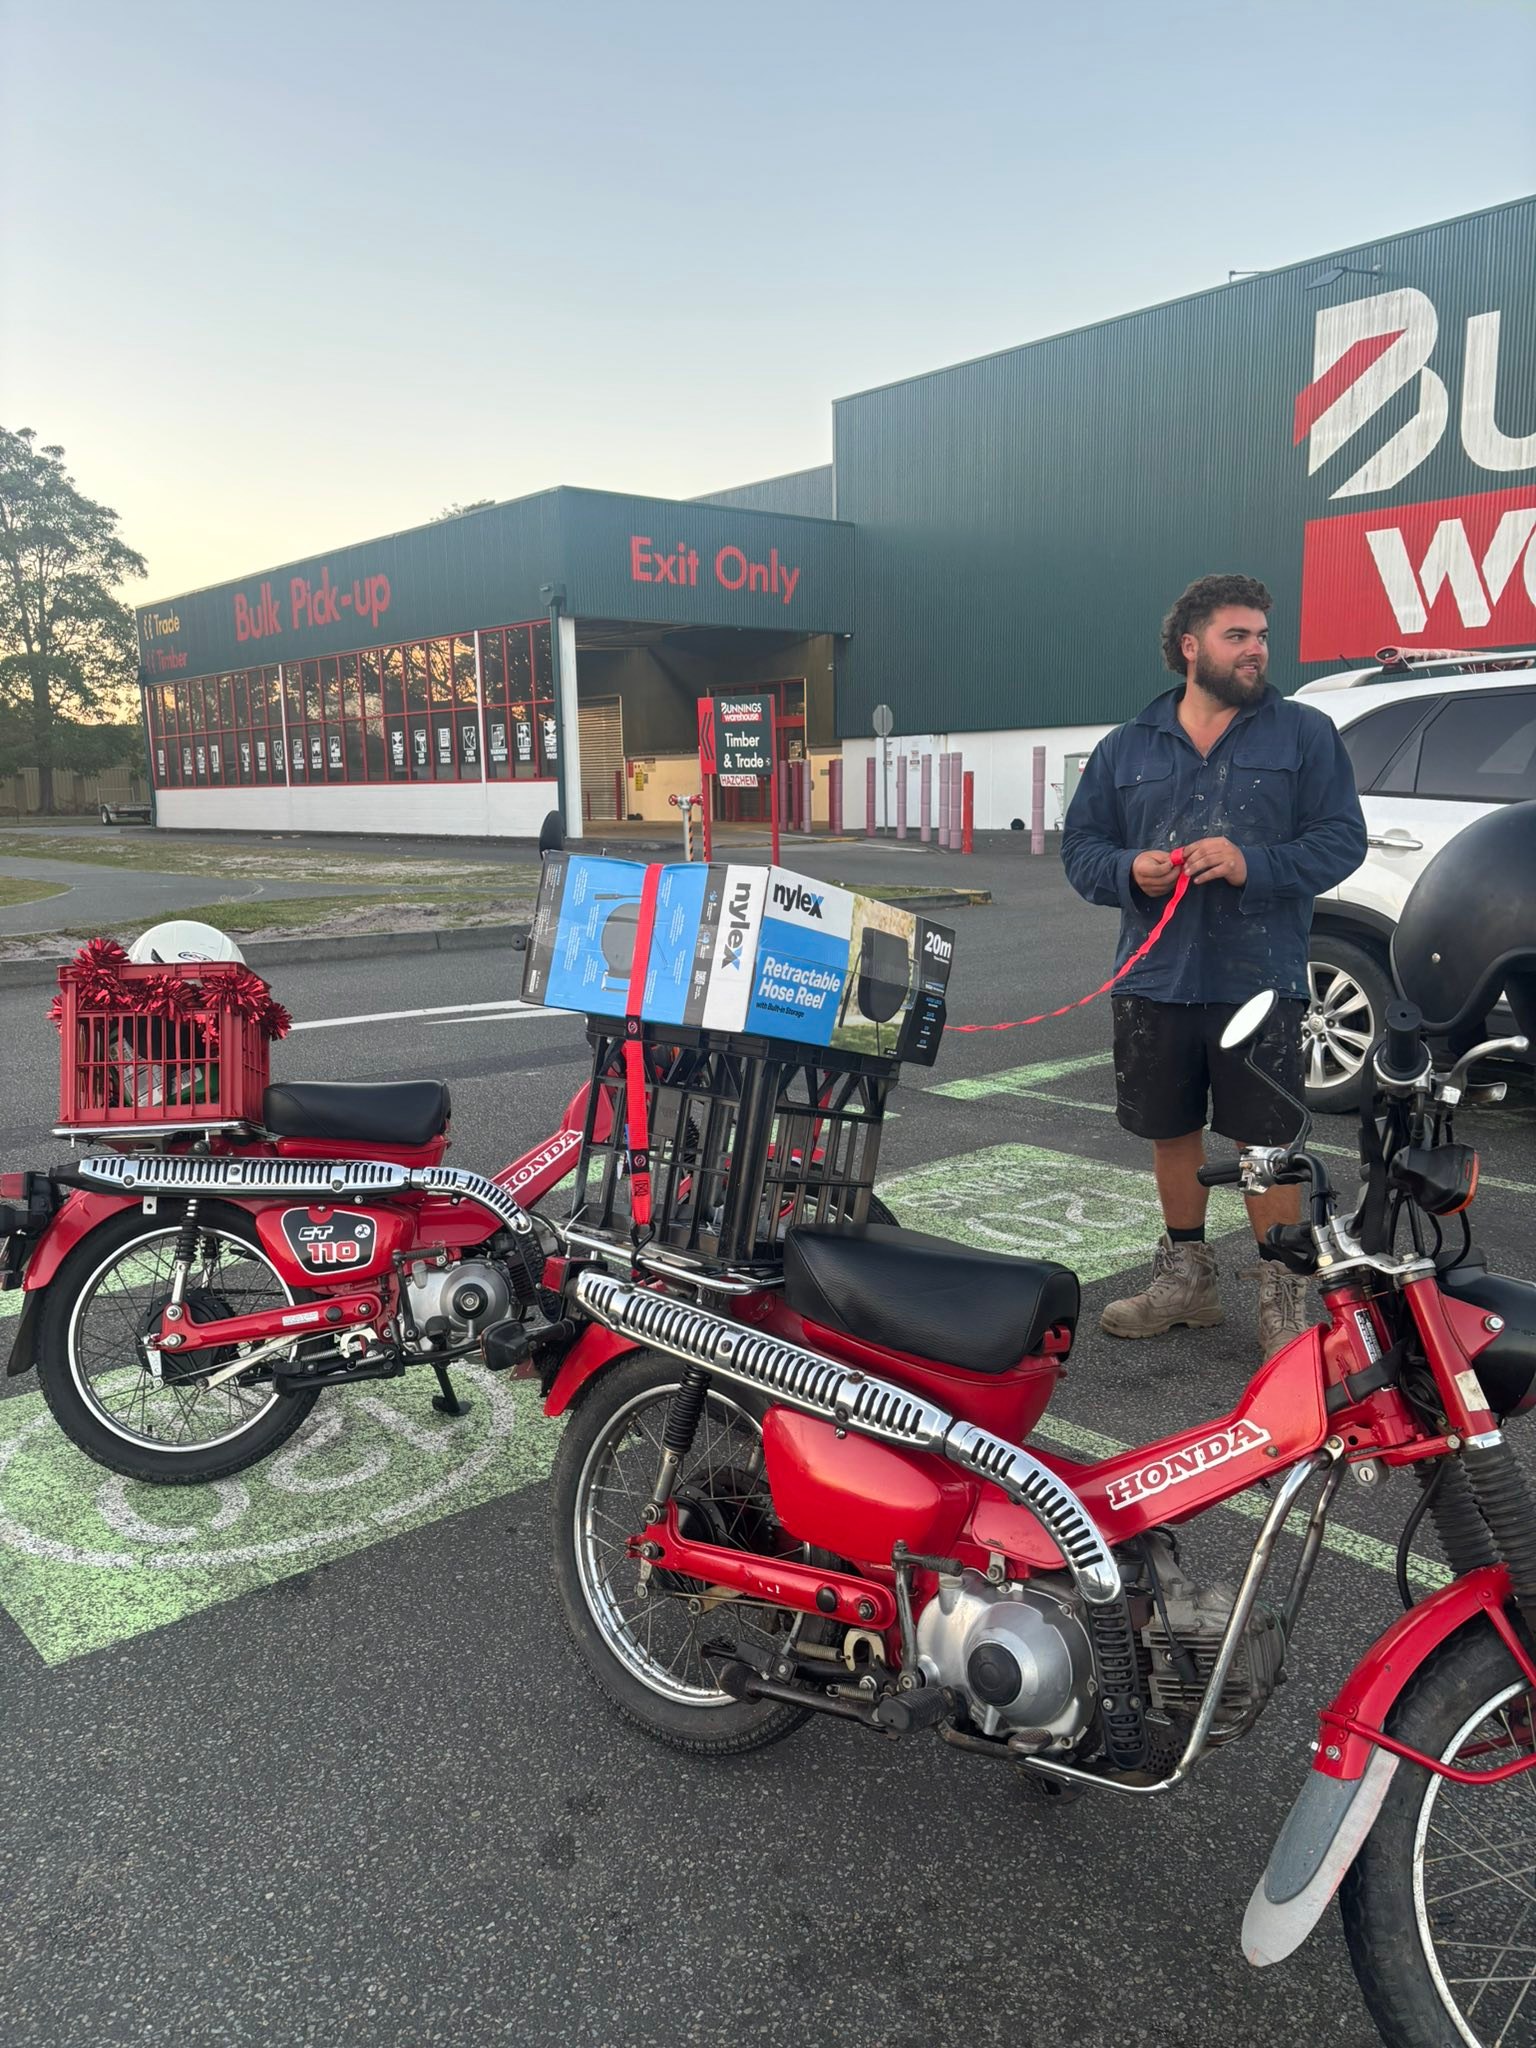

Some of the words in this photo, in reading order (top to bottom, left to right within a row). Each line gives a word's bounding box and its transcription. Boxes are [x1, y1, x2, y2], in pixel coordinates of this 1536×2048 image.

[630, 535, 699, 587] Exit
[714, 545, 800, 605] Only
[234, 580, 283, 642] Bulk
[290, 565, 391, 630] Pick-up
[153, 608, 181, 637] Trade
[156, 646, 188, 673] Timber
[721, 702, 762, 714] BUNNINGS
[724, 712, 760, 722] warehouse
[724, 731, 760, 747] Timber
[723, 753, 733, 768] &
[735, 752, 764, 768] Trade
[721, 775, 757, 786] HAZCHEM
[772, 883, 825, 920] nylex
[721, 882, 752, 971] nylex
[924, 931, 952, 958] 20m
[762, 955, 841, 993] Retractable
[758, 977, 795, 1003] Hose
[795, 984, 826, 1009] Reel
[755, 1001, 767, 1009] with
[785, 1006, 805, 1019] Storage
[298, 1225, 334, 1241] CT
[307, 1240, 360, 1264] 110
[1105, 1419, 1272, 1511] HONDA
